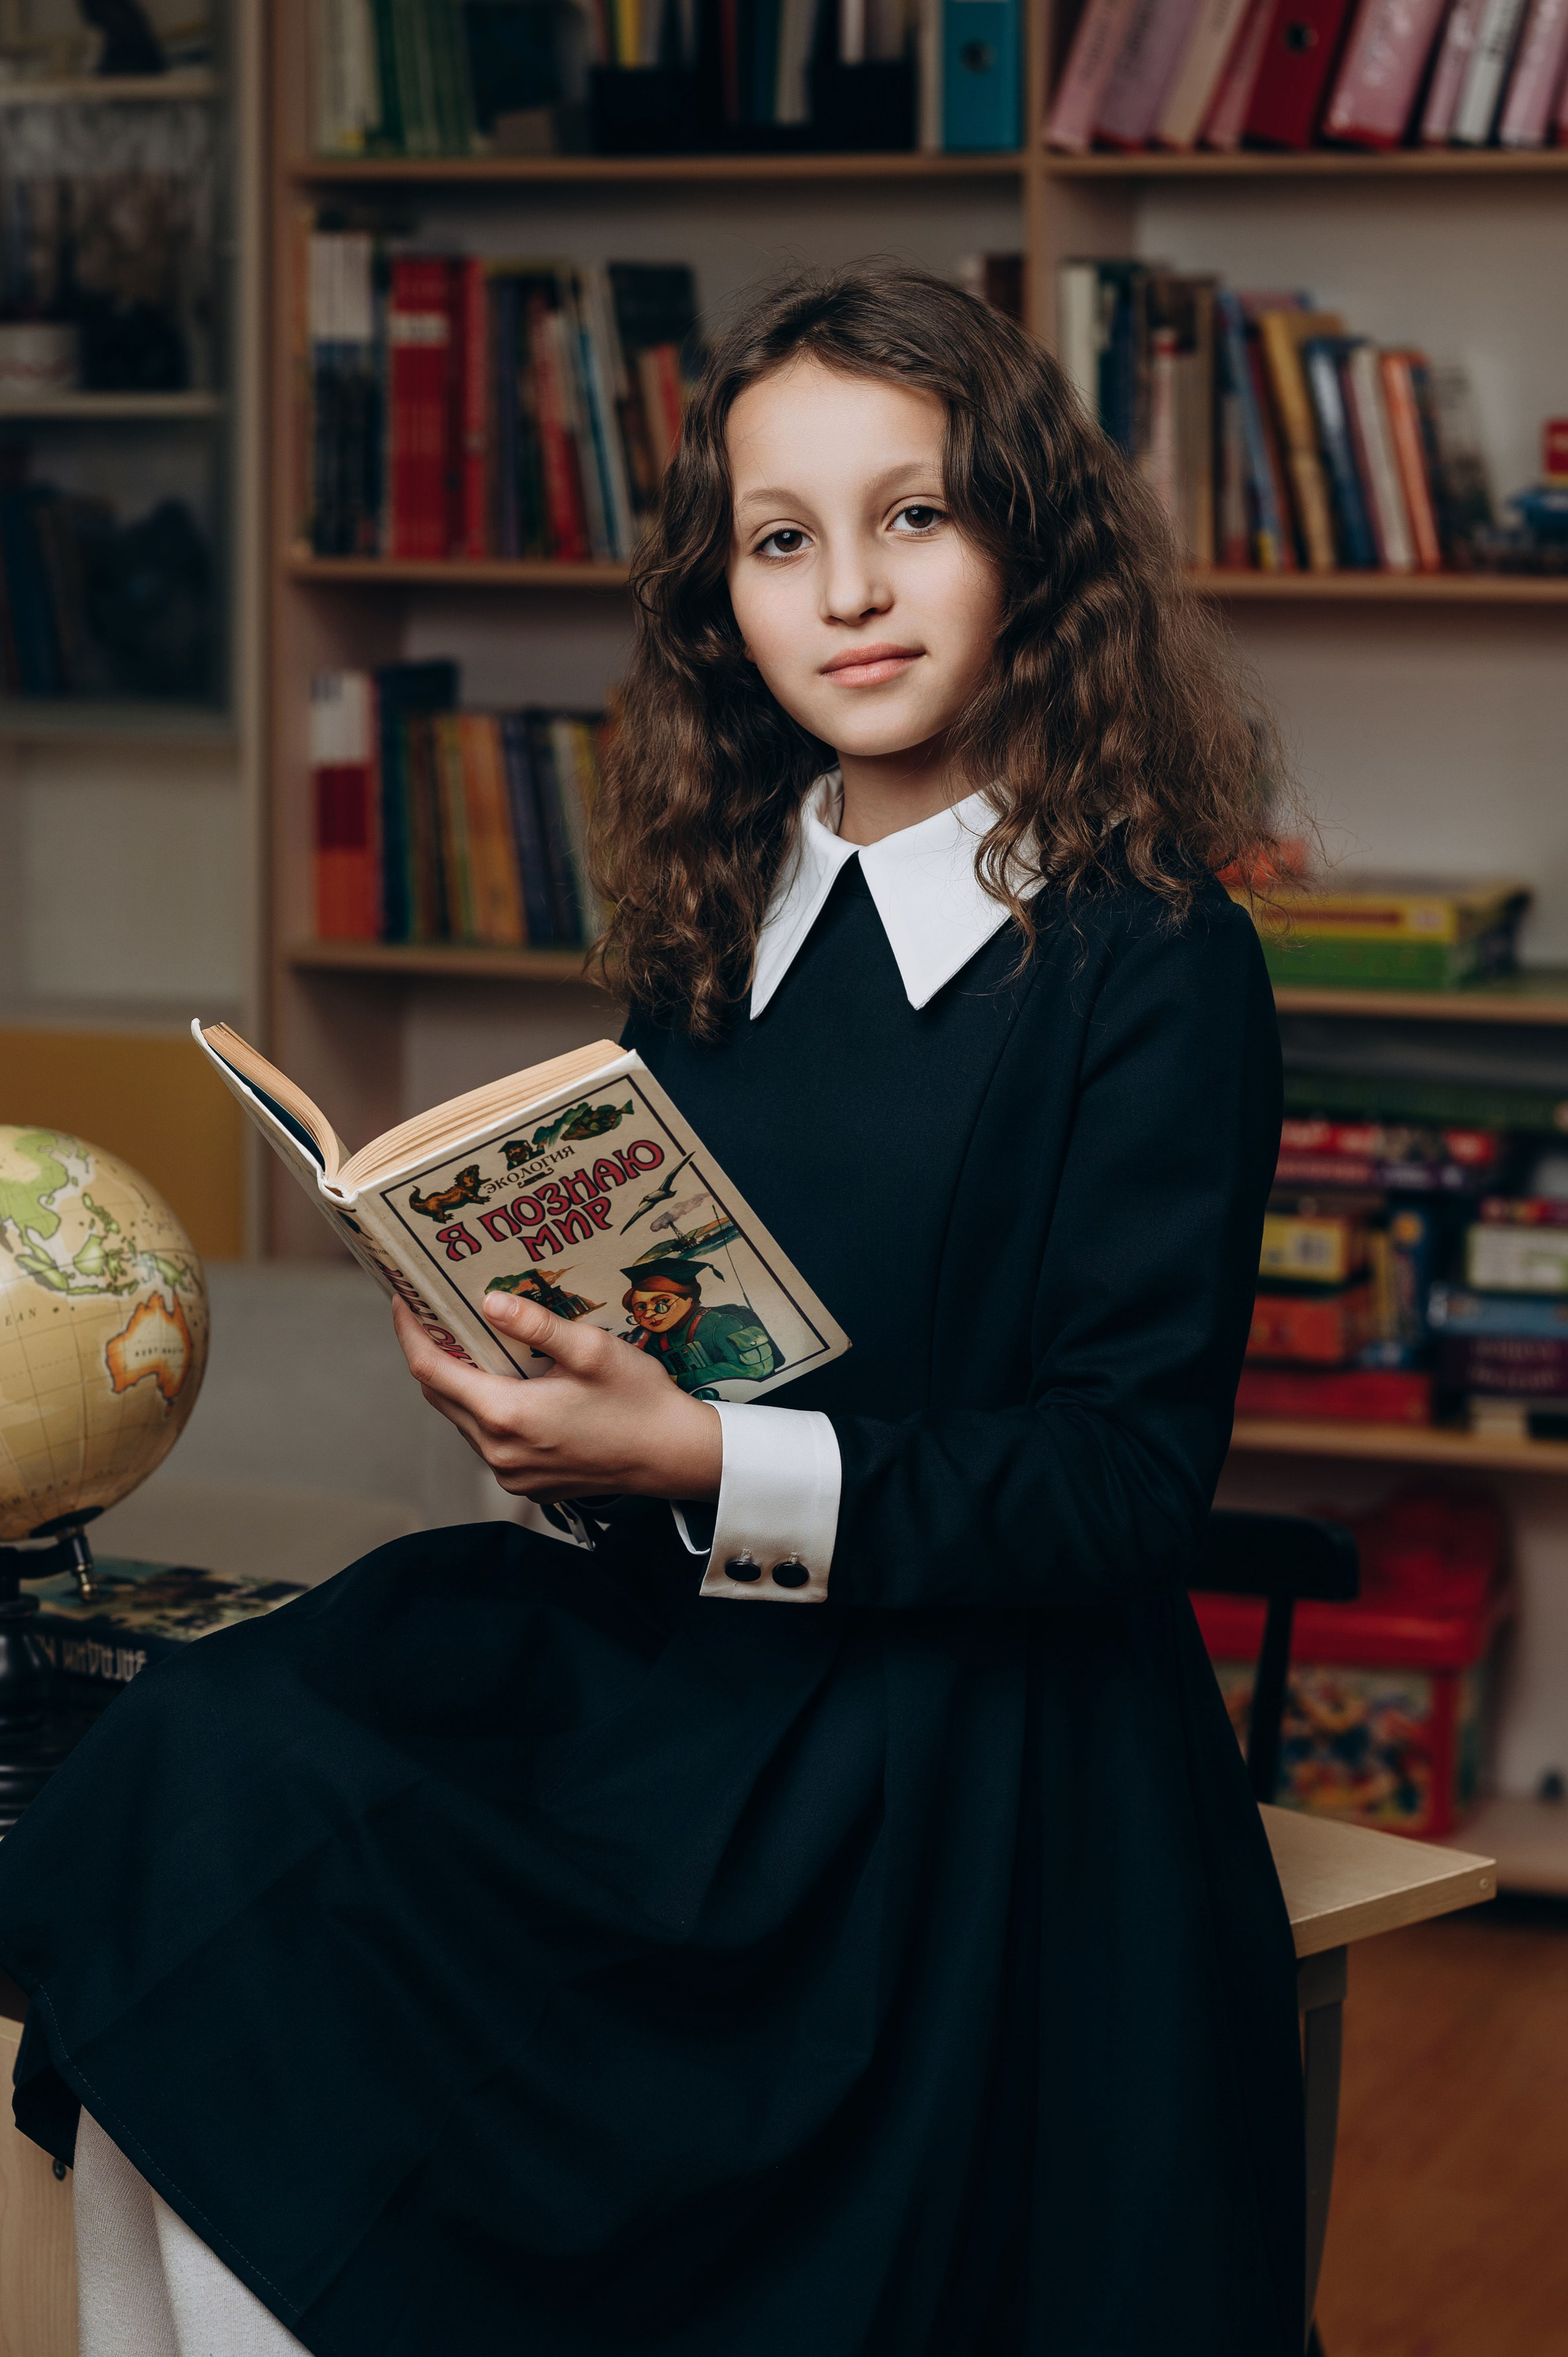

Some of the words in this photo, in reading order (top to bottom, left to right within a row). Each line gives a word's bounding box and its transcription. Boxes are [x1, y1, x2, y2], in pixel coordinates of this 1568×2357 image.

[435, 1221, 482, 1262] Я
[477, 1139, 665, 1243] ПОЗНАЮ
[484, 1145, 576, 1194] ЭКОЛОГИЯ
[516, 1196, 614, 1262] МИР
